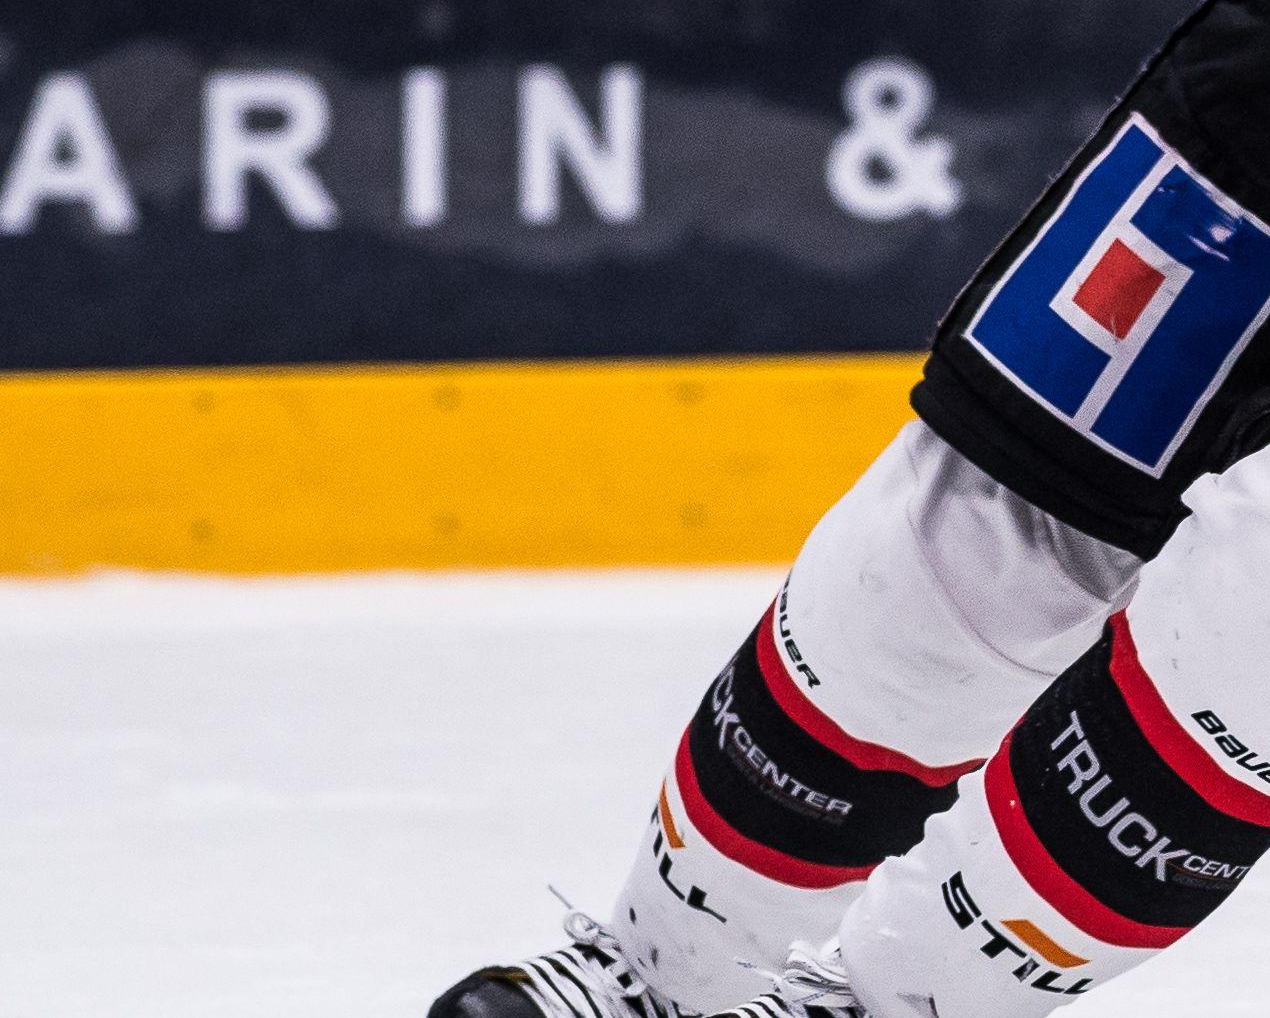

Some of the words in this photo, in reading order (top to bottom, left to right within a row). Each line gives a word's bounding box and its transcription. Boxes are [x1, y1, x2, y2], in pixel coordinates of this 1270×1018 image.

[826, 55, 963, 222] &
[733, 725, 853, 815] CENTER
[1050, 710, 1191, 882] TRUCK
